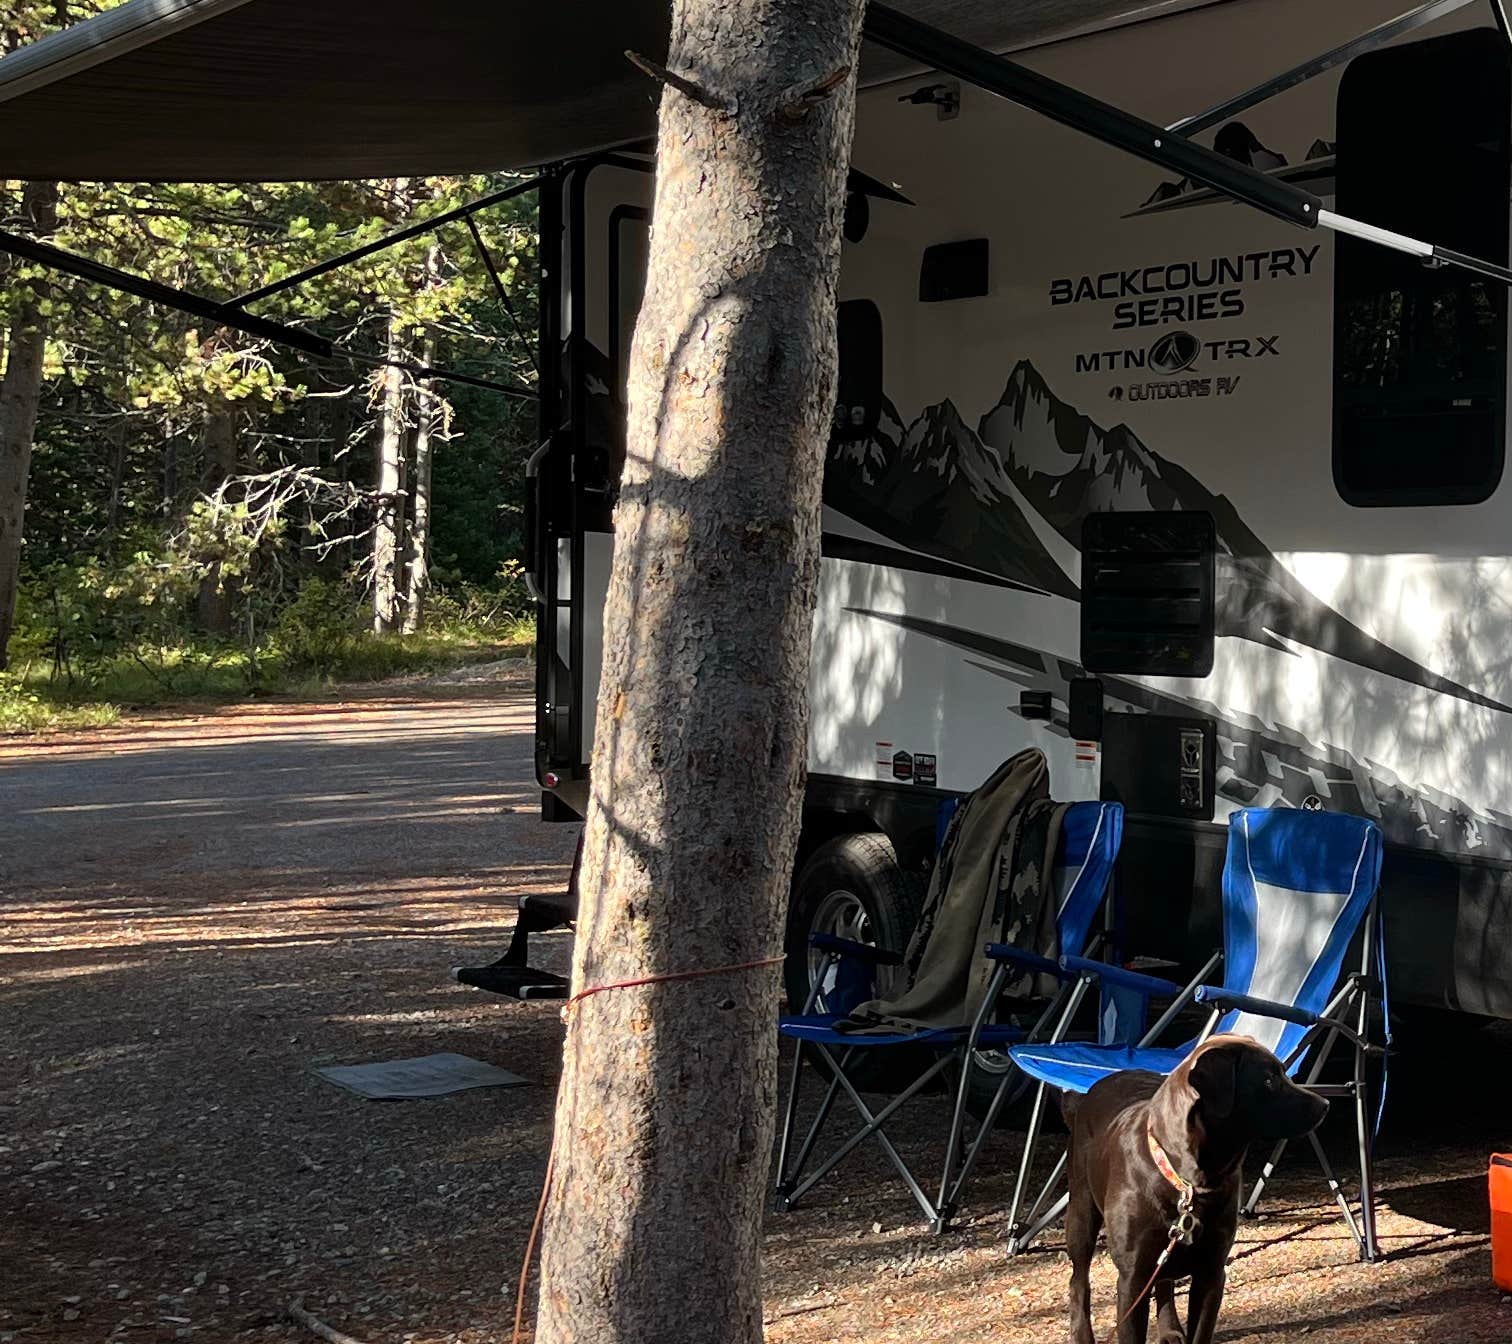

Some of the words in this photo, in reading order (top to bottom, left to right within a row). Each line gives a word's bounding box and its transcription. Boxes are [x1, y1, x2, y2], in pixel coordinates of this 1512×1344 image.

[1049, 245, 1321, 305] BACKCOUNTRY
[1112, 289, 1245, 329] SERIES
[1075, 349, 1145, 373] MTN
[1204, 335, 1280, 361] TRX
[1128, 378, 1211, 402] OUTDOORS
[1216, 376, 1241, 396] RV
